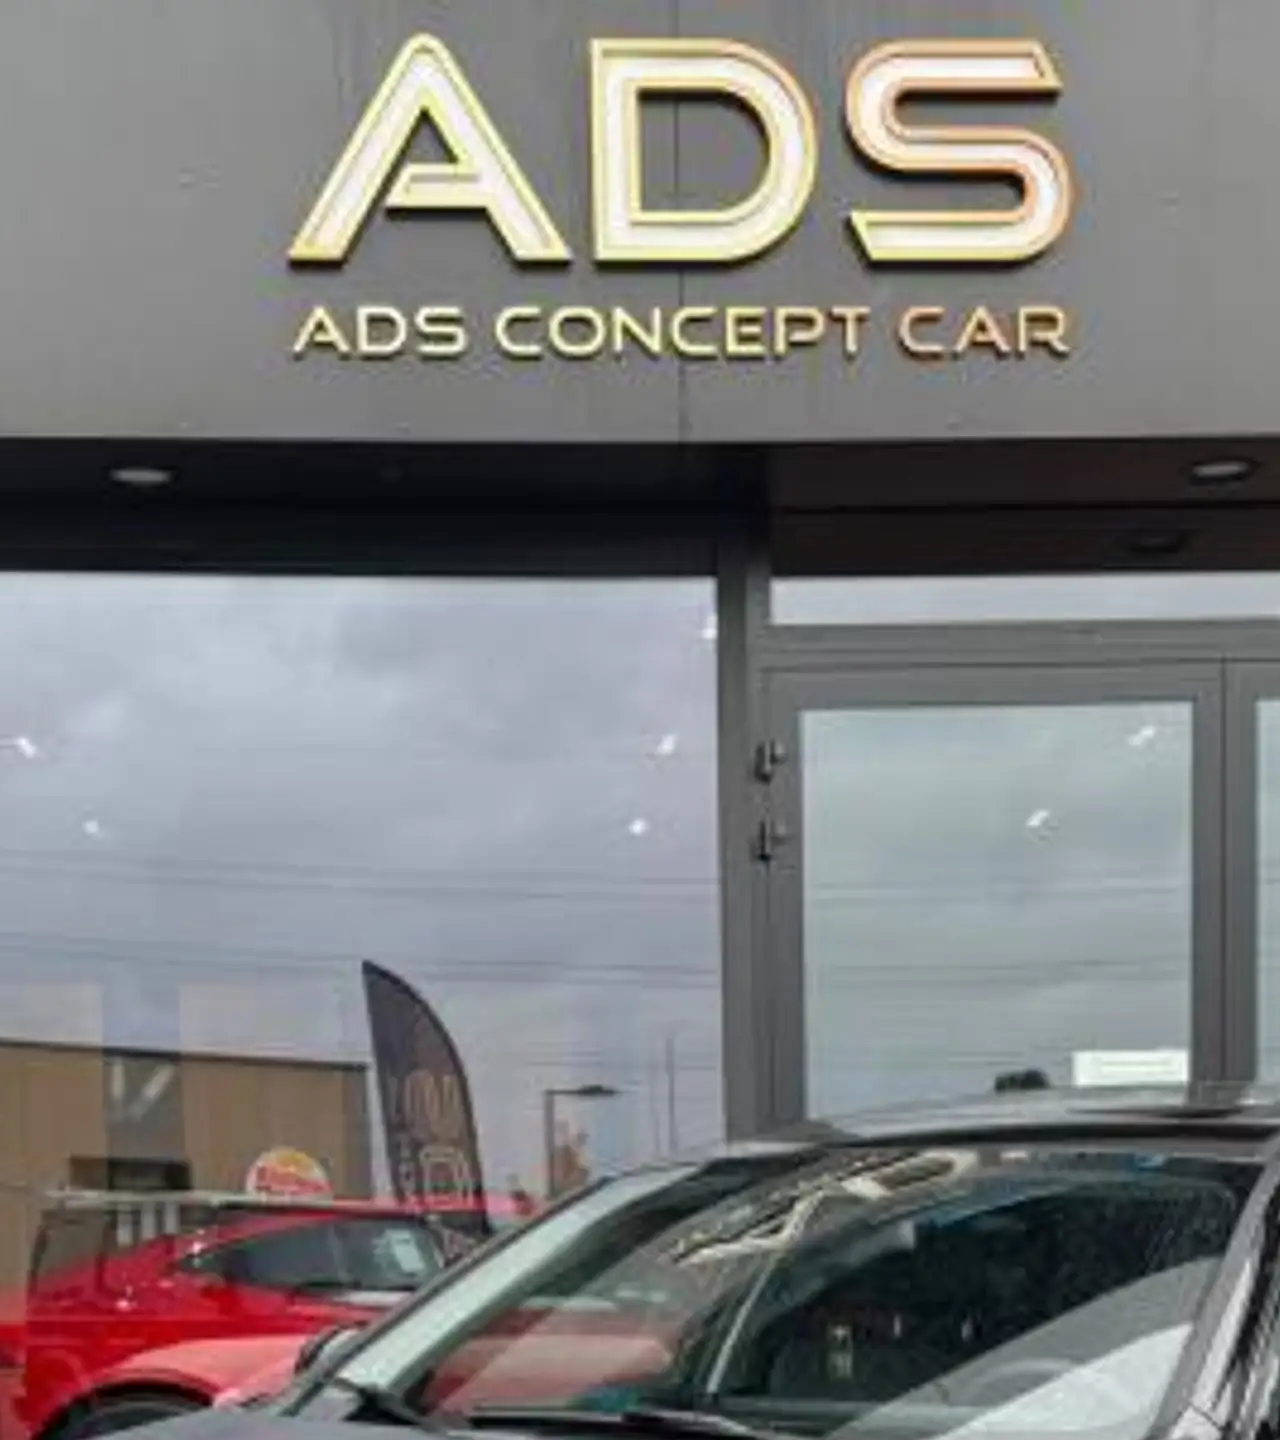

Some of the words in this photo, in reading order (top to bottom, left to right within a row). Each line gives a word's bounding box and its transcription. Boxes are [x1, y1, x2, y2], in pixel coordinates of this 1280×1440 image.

[288, 31, 1072, 268] ADS
[291, 304, 466, 358] ADS
[494, 304, 870, 358] CONCEPT
[898, 304, 1072, 359] CAR
